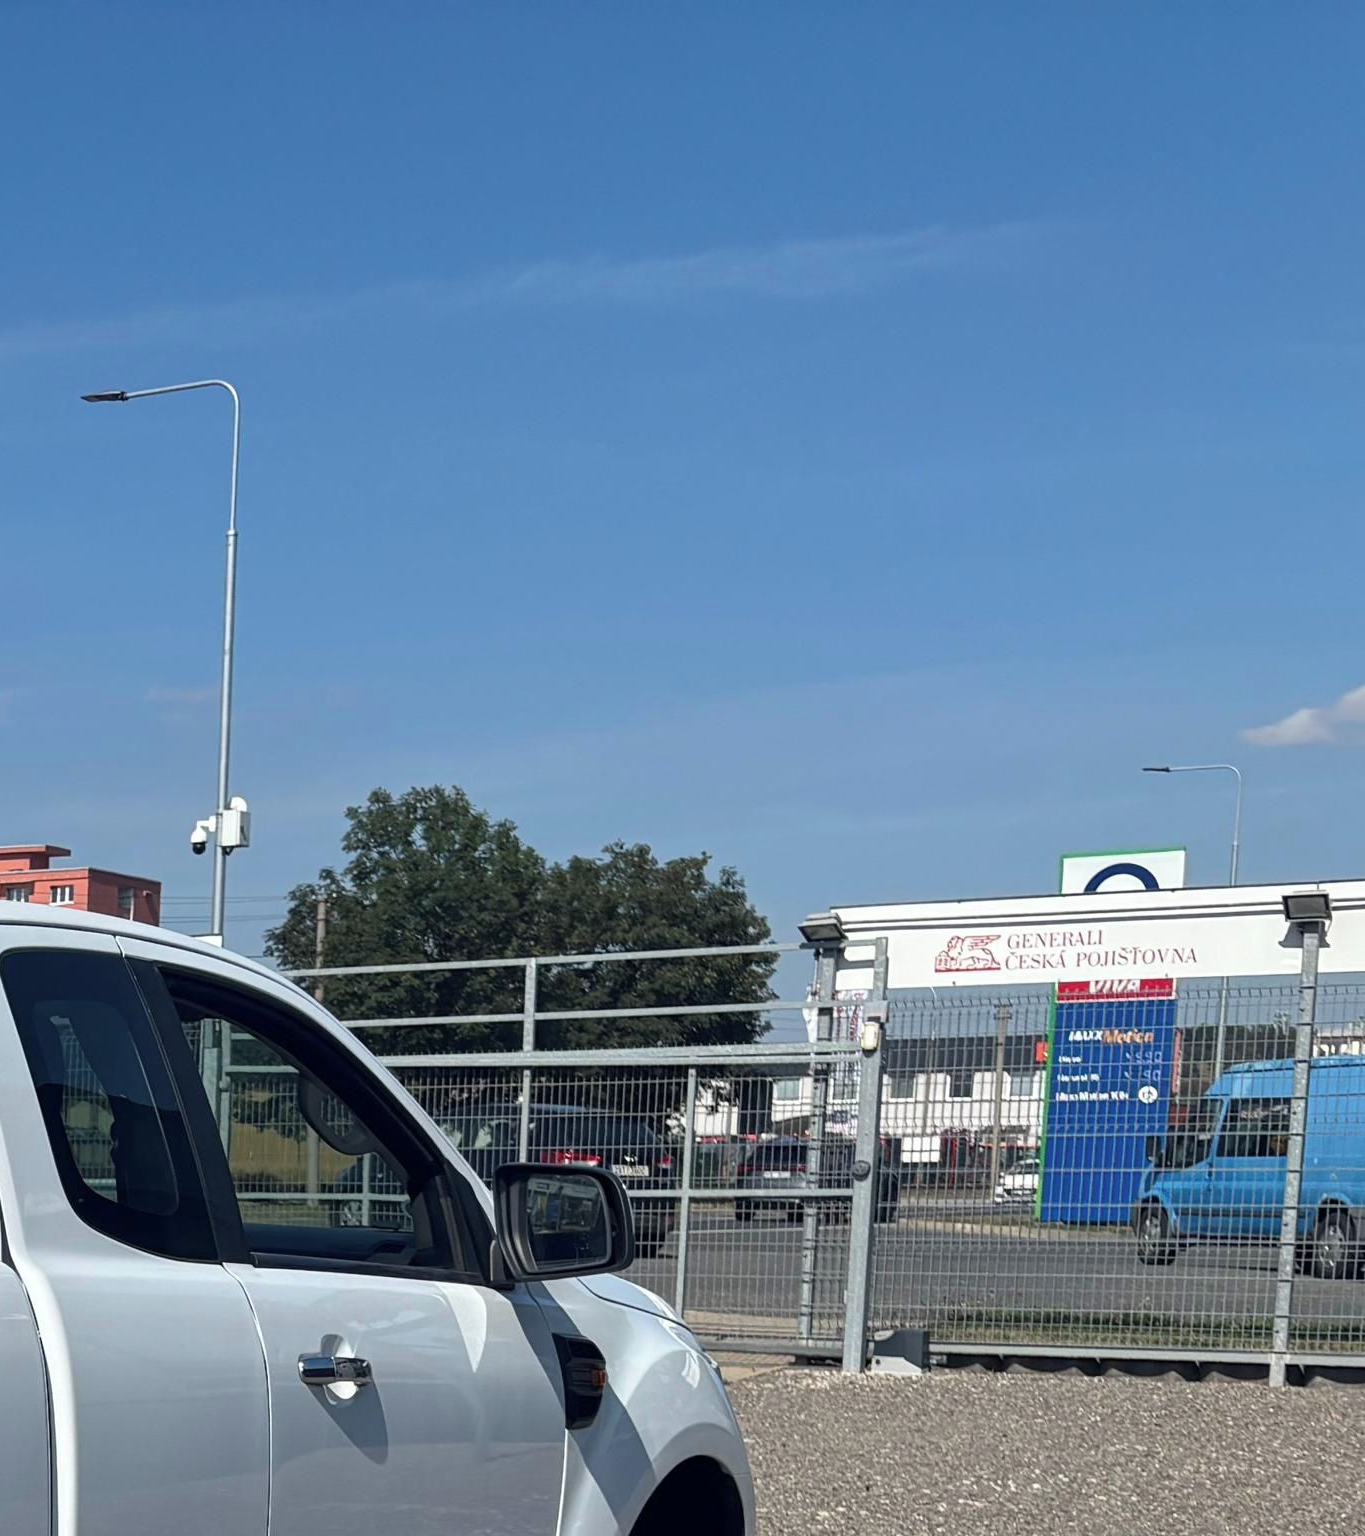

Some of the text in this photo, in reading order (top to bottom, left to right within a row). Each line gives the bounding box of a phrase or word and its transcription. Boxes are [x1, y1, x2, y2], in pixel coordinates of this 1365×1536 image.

[1007, 930, 1103, 950] GENERALI
[1005, 947, 1198, 971] ČESKÁ POJIŠŤOVNA
